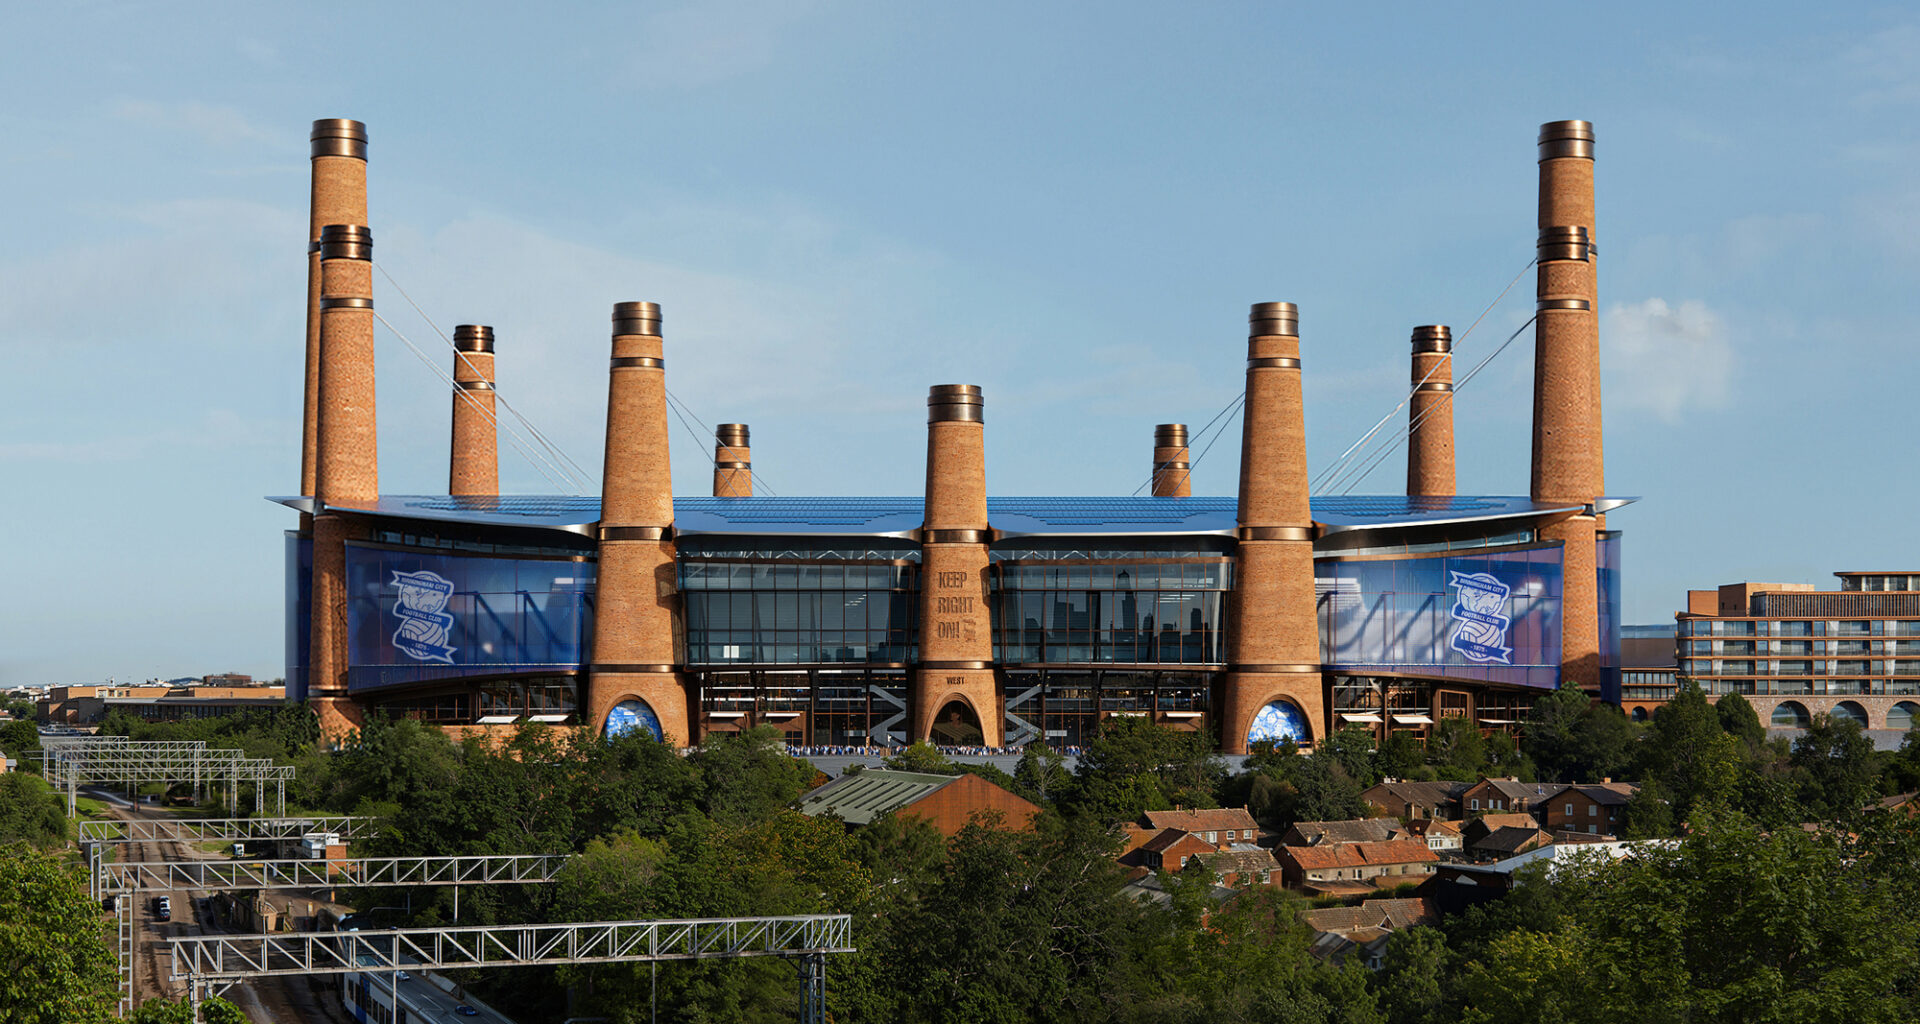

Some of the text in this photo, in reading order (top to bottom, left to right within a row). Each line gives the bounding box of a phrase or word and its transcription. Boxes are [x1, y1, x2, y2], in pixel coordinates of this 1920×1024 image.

[434, 583, 447, 591] CITY
[938, 572, 967, 588] KEEP
[938, 596, 974, 613] RIGHT
[402, 609, 427, 620] FOOTBALL
[1461, 611, 1500, 625] FOOTBALL CLUB
[938, 621, 960, 639] ON!
[946, 676, 964, 685] WEST
